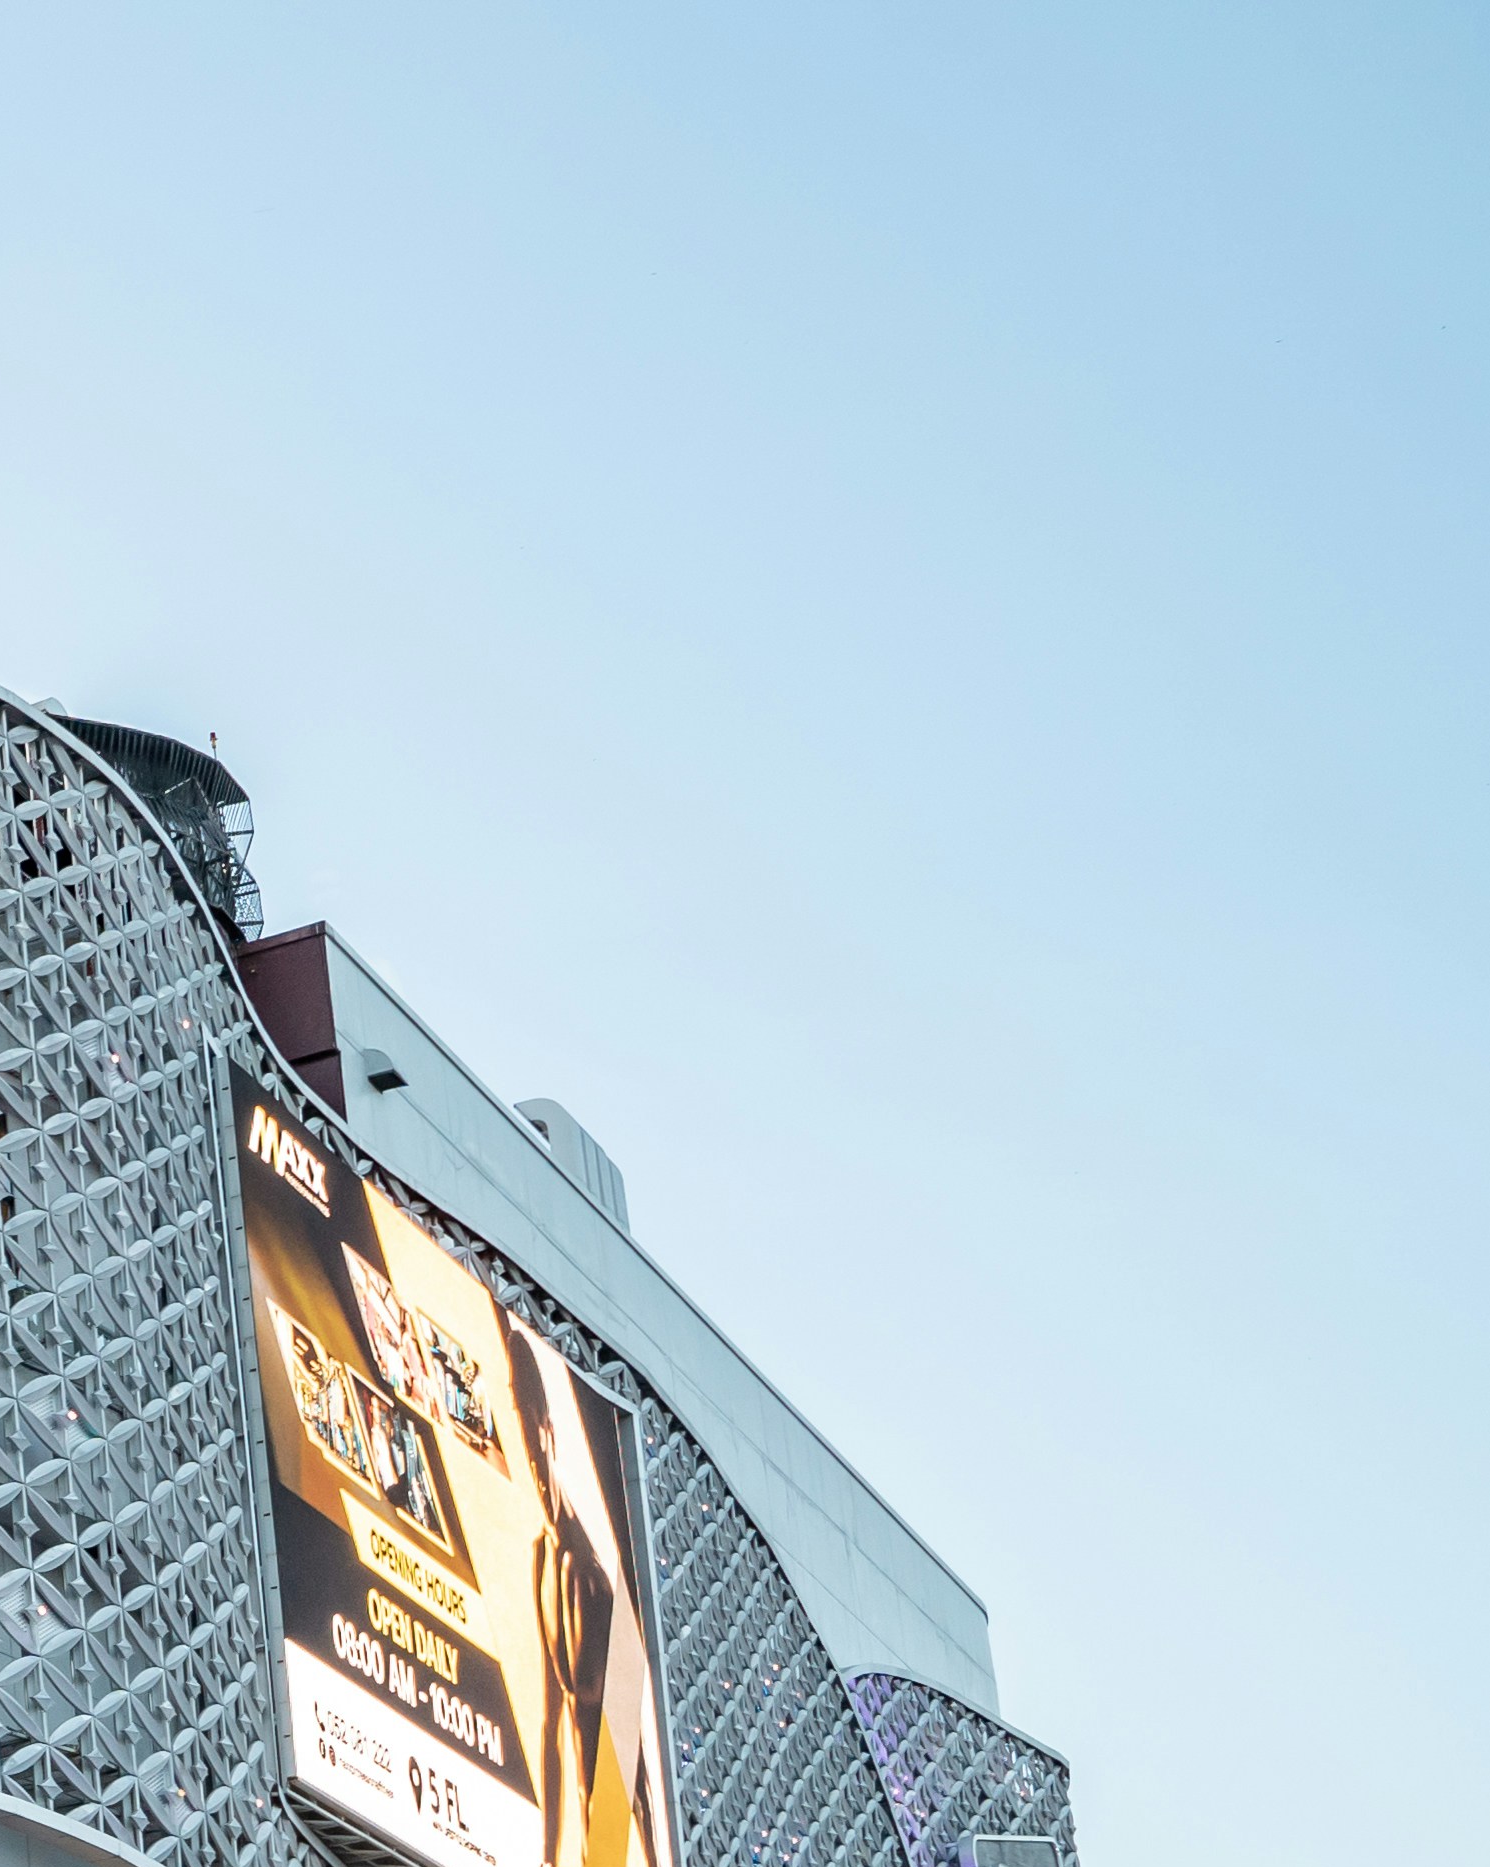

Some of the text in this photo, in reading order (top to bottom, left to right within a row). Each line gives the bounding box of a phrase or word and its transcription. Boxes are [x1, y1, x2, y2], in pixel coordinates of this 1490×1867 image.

[248, 1105, 329, 1203] MAXX
[370, 1528, 467, 1625] OPENING HOURS
[367, 1588, 459, 1685] OPEN DAILY
[332, 1613, 386, 1685] 08:00
[389, 1653, 418, 1708] AM
[429, 1682, 476, 1748] 10:00
[475, 1713, 505, 1767] PM
[428, 1767, 440, 1815] 5
